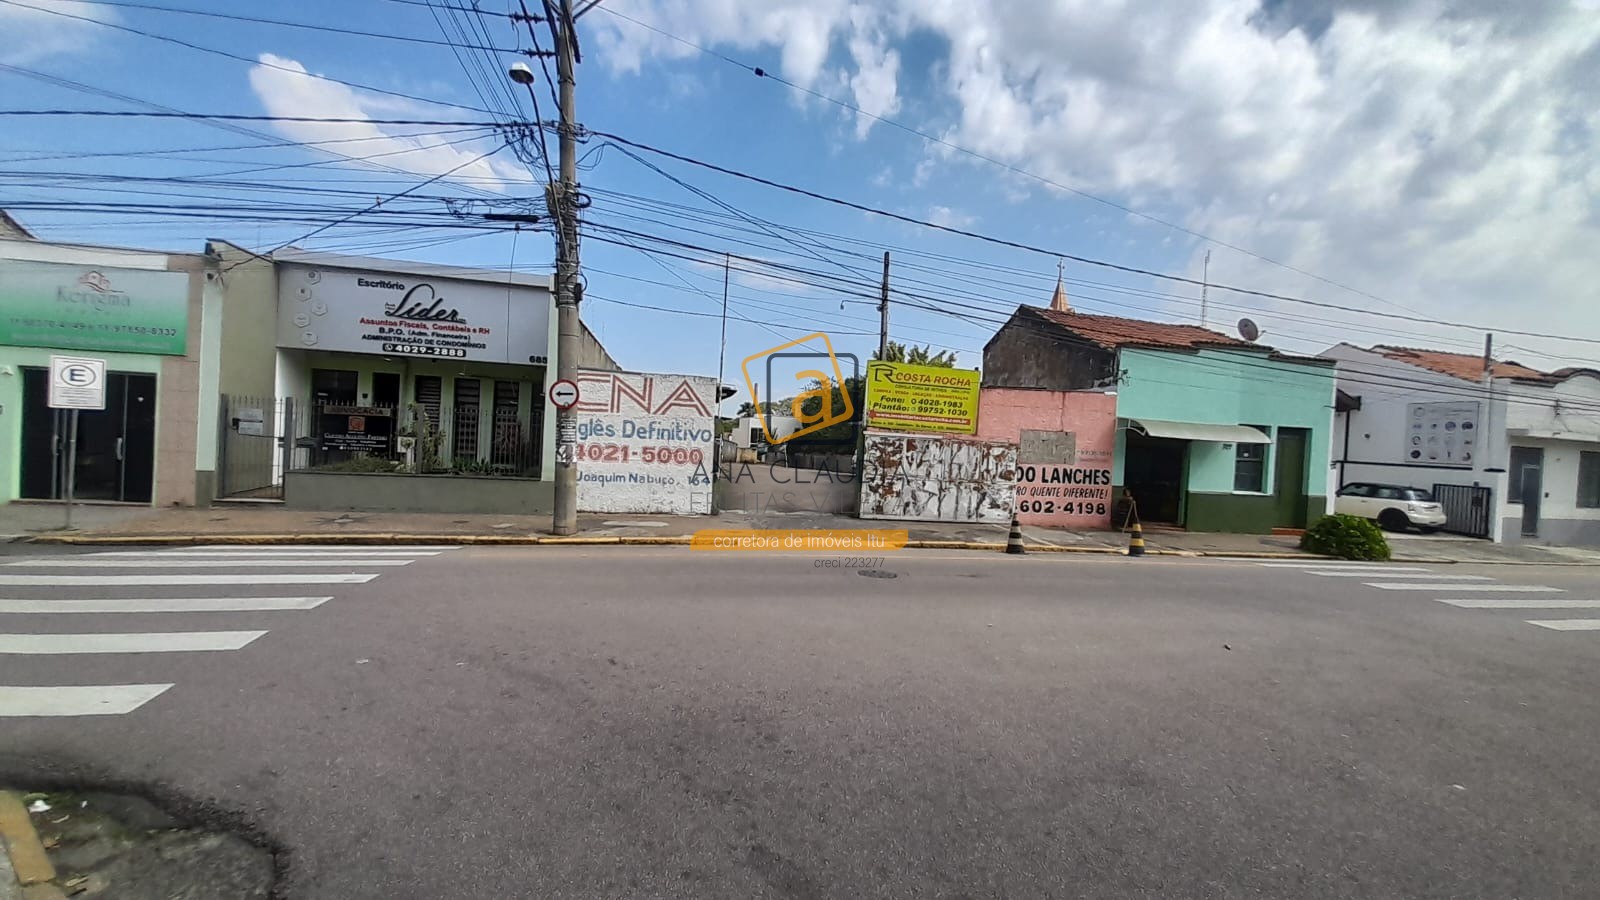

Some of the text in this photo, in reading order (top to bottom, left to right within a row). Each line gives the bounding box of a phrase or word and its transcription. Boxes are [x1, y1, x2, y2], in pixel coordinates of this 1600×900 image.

[357, 278, 405, 290] Escritório
[360, 317, 397, 327] Assuntos
[399, 319, 429, 330] Fiscais,
[432, 323, 471, 333] Contábeis
[479, 327, 490, 335] RH
[379, 327, 405, 335] B.P.O.
[408, 329, 429, 337] (Adm.
[361, 333, 423, 345] ADMINISTRAÇÃO
[436, 339, 487, 349] CONDOMÍNIOS
[395, 345, 464, 357] 4029-2888
[69, 368, 87, 382] E
[896, 372, 931, 384] COSTA
[933, 376, 971, 387] ROCHA
[880, 395, 906, 404] Fone:
[872, 401, 968, 416] Plantão: 99752-1030
[578, 418, 616, 441] glês
[622, 420, 712, 442] Definitivo
[576, 471, 626, 488] Joaquim
[687, 476, 711, 486] 164
[1041, 466, 1111, 486] LANCHES
[1030, 487, 1061, 498] QUENTE
[1063, 487, 1108, 500] DIFERENTE!
